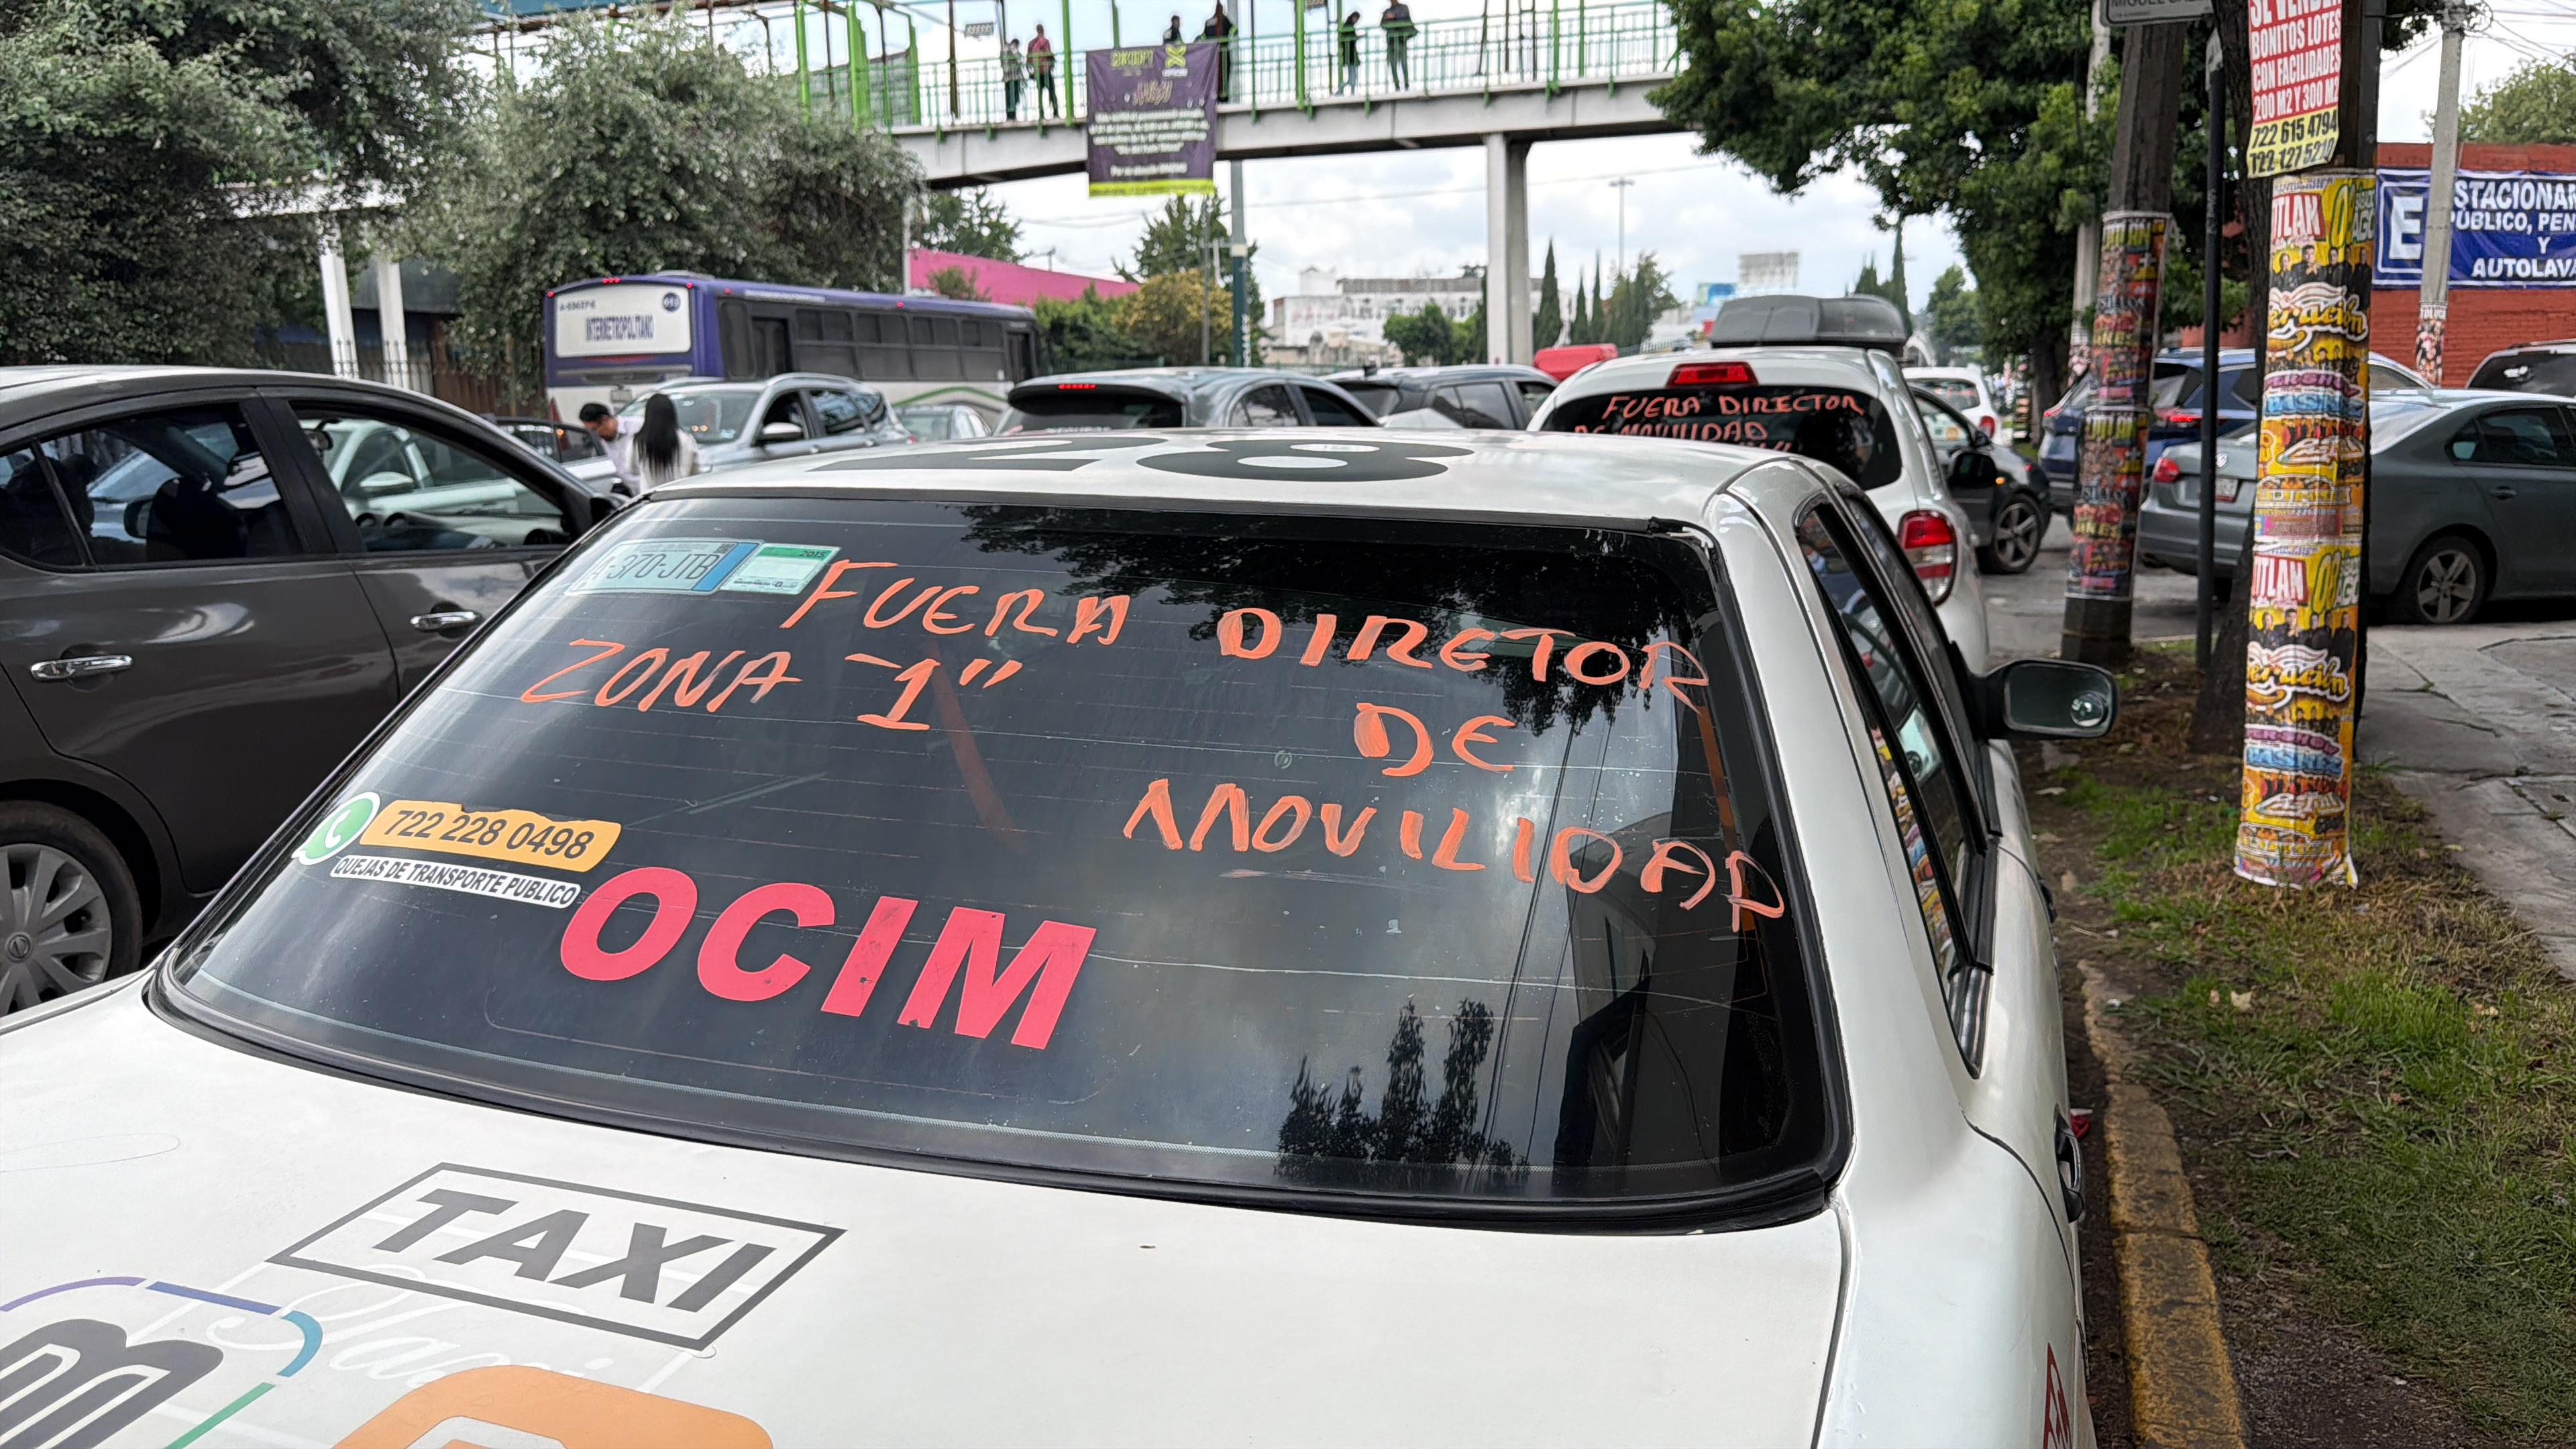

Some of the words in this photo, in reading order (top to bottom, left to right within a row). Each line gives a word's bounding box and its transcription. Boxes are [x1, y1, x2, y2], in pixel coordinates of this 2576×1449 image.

[2251, 19, 2305, 59] BONITOS
[2308, 8, 2341, 46] LOTES
[2277, 0, 2341, 21] VEN
[2253, 60, 2275, 93] CON
[2277, 42, 2341, 87] FACILIDADES
[2254, 93, 2275, 121] 200
[2277, 88, 2293, 117] M2
[2294, 85, 2302, 113] Y
[2302, 80, 2323, 111] 300
[2252, 123, 2278, 149] 722
[2280, 117, 2305, 144] 615
[2308, 109, 2337, 138] 4794
[2249, 150, 2275, 174] 722
[2279, 145, 2302, 169] 127
[2537, 236, 2551, 254] Y
[1601, 395, 1701, 420] FUERA
[1719, 393, 1865, 415] DIRECTOR
[585, 553, 720, 580] A-370-JTB
[779, 559, 1131, 645] FUERA
[1217, 607, 1710, 715] DIRETOR
[521, 638, 802, 713] ZONA
[1353, 702, 1516, 777] DE
[384, 810, 444, 838] 722
[439, 816, 504, 846] 228
[506, 822, 595, 861] 0498
[1122, 778, 1785, 933] MOVILIDAD
[334, 857, 388, 877] QUEJAS
[386, 863, 407, 879] DE
[406, 864, 506, 894] TRANSPORTE
[505, 878, 578, 906] PUBLICO
[560, 866, 1097, 1050] OCIM
[373, 1187, 778, 1313] TAXI
